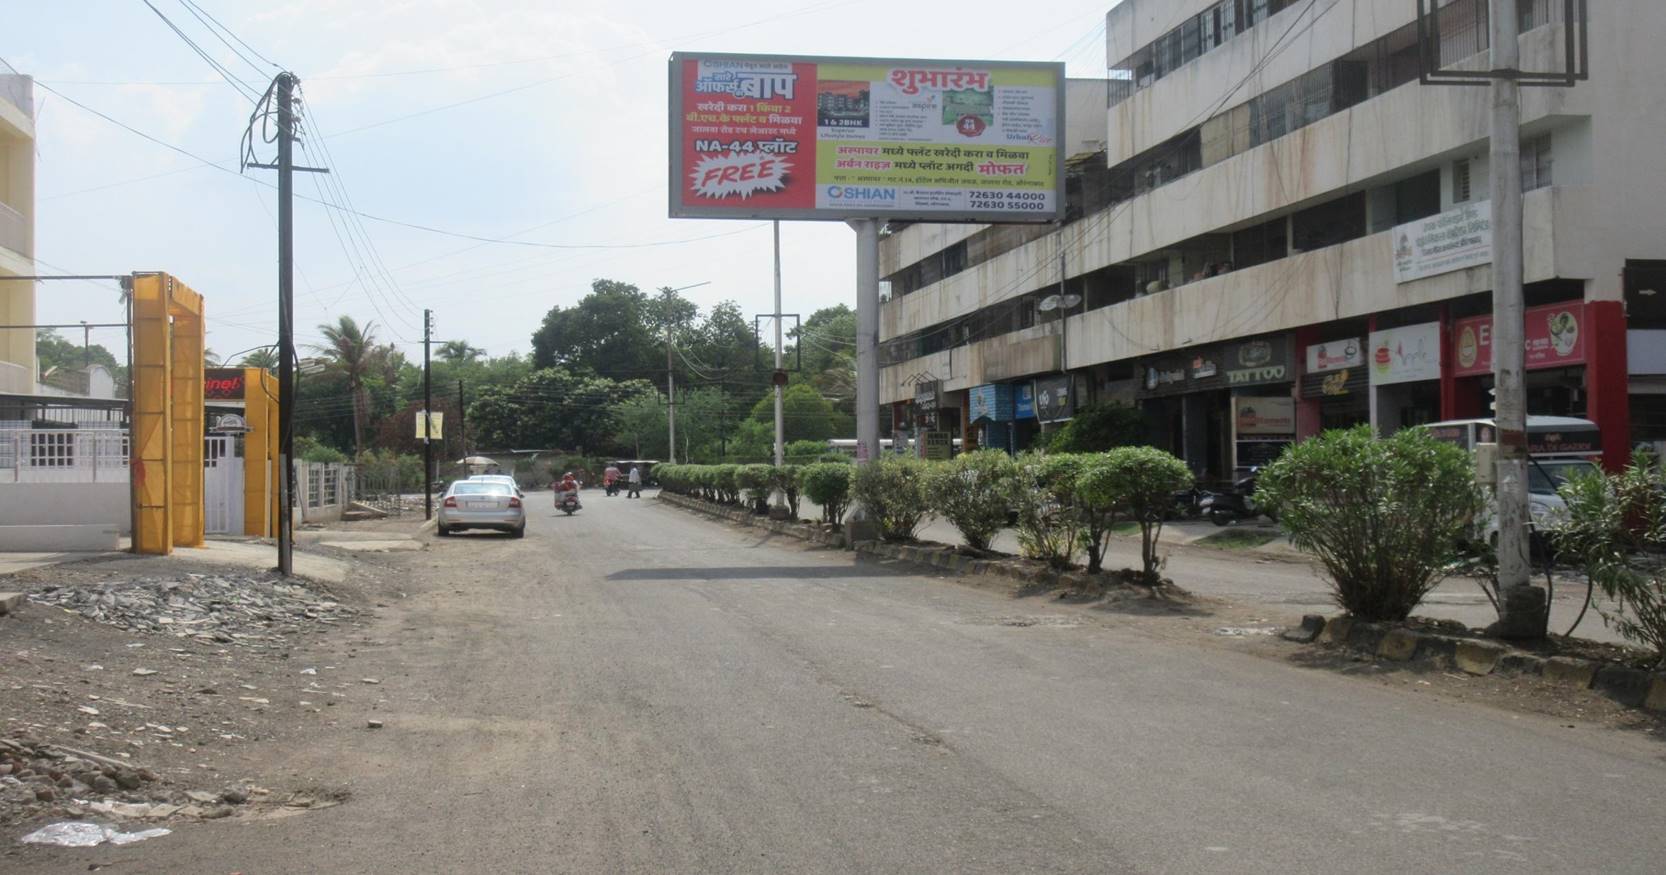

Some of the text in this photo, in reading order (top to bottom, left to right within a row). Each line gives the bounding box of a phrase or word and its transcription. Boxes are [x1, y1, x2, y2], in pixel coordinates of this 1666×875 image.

[737, 72, 797, 99] बाप
[891, 66, 989, 95] शुभारंभ
[696, 101, 724, 112] खरेदी
[727, 103, 747, 112] करा
[695, 140, 754, 152] NA-44
[882, 146, 904, 155] मध्ये
[934, 147, 961, 158] खरेदी
[963, 149, 984, 157] करा
[995, 148, 1029, 159] मिळवा
[700, 159, 776, 188] FREE
[894, 160, 916, 169] मध्ये
[945, 160, 973, 171] अगदी
[977, 159, 1024, 175] मोफत
[827, 185, 895, 200] OSHIAN
[968, 190, 1003, 199] 72630
[1006, 191, 1046, 201] 44000
[969, 200, 1045, 210] 72630 55000
[1226, 365, 1285, 384] TATTOO
